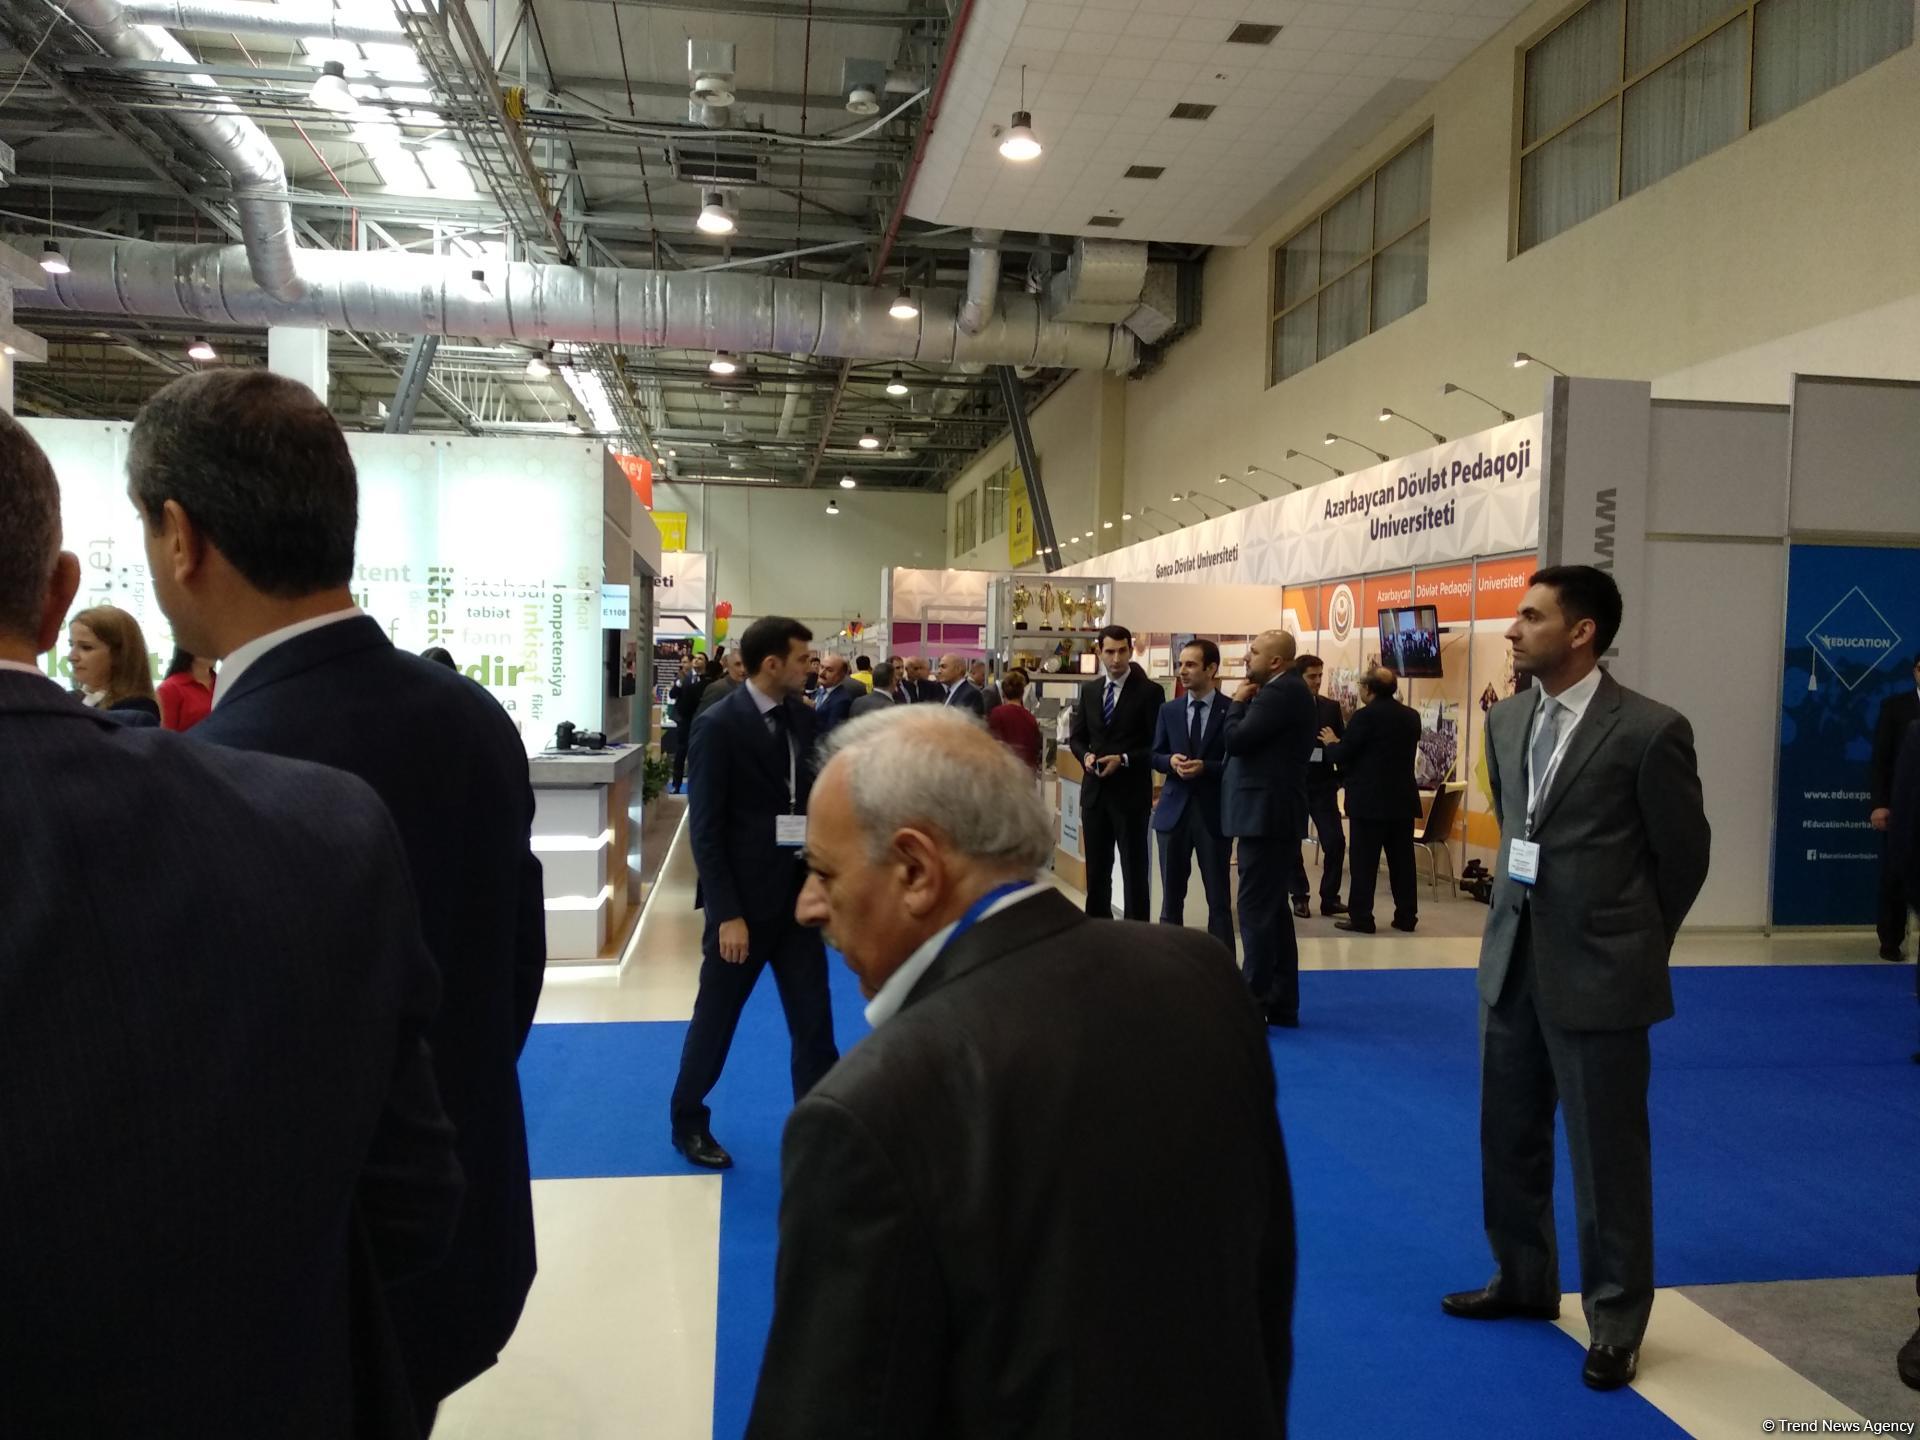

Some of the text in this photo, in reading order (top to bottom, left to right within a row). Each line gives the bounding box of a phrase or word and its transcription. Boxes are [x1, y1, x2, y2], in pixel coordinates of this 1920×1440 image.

[618, 456, 643, 481] key
[1324, 439, 1531, 520] Azərbaycan Dövlət Pedaqoji
[1370, 499, 1455, 541] Universiteti
[1175, 555, 1195, 574] Dövlət
[1197, 543, 1239, 569] Universiteti
[353, 563, 411, 583] tent
[654, 575, 674, 588] eti
[1377, 573, 1525, 603] Azərbaycan Dövlət Pedaqoji Universiteti
[467, 606, 511, 619] təbiət
[463, 628, 512, 646] fənn
[1831, 637, 1891, 649] EDUCATION
[457, 655, 525, 687] dir
